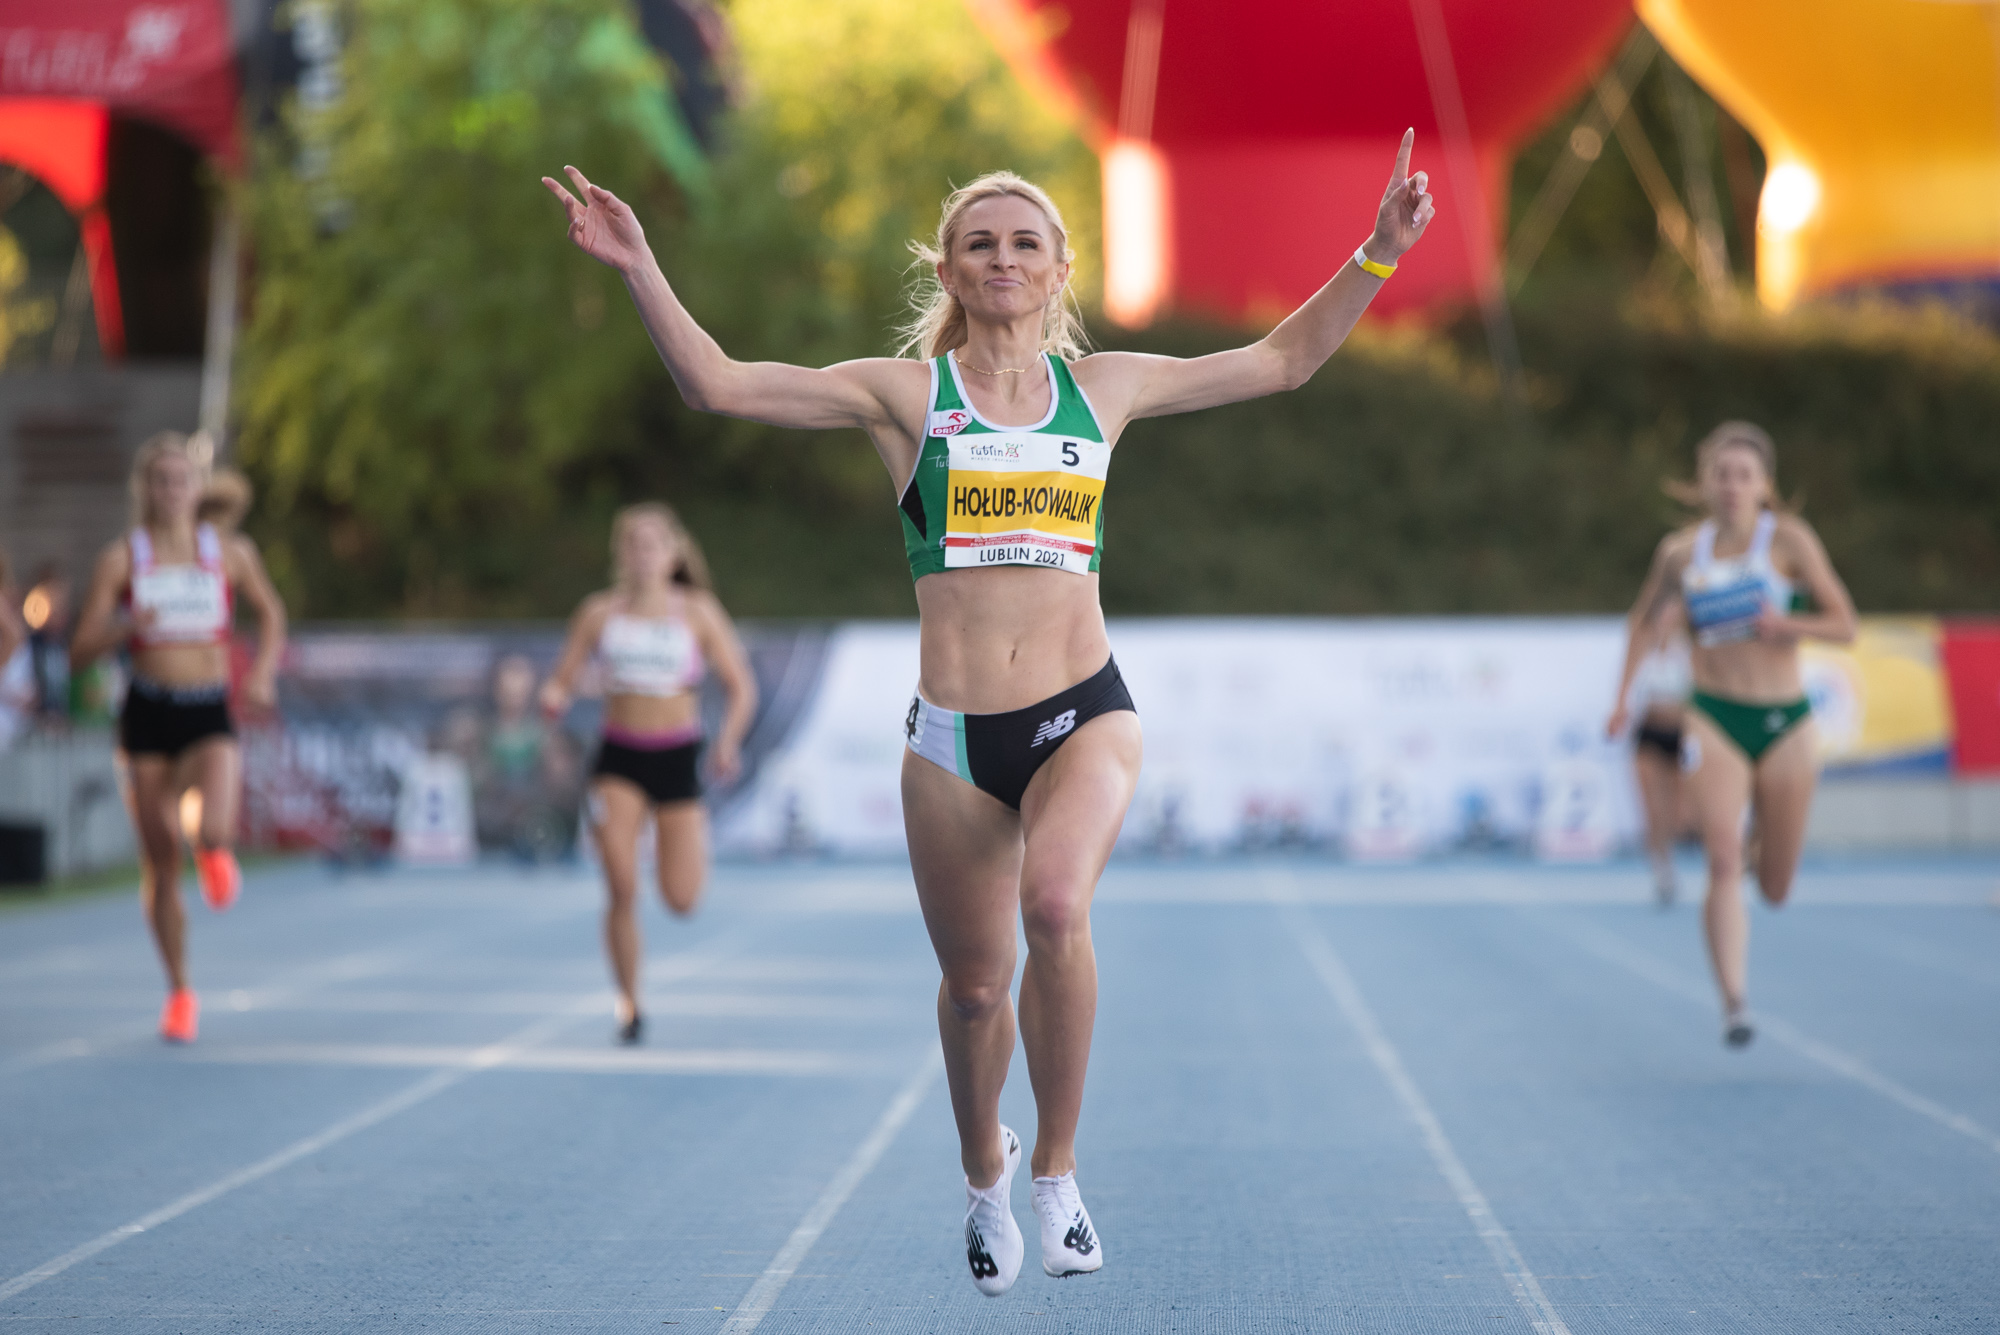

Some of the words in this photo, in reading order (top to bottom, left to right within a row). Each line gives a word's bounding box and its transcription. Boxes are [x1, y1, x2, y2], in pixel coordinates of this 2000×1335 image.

[1062, 442, 1080, 467] 5
[954, 486, 1097, 524] HOŁUB-KOWALIK
[980, 547, 1030, 563] LUBLIN
[1034, 549, 1065, 567] 2021
[1031, 709, 1077, 748] NB
